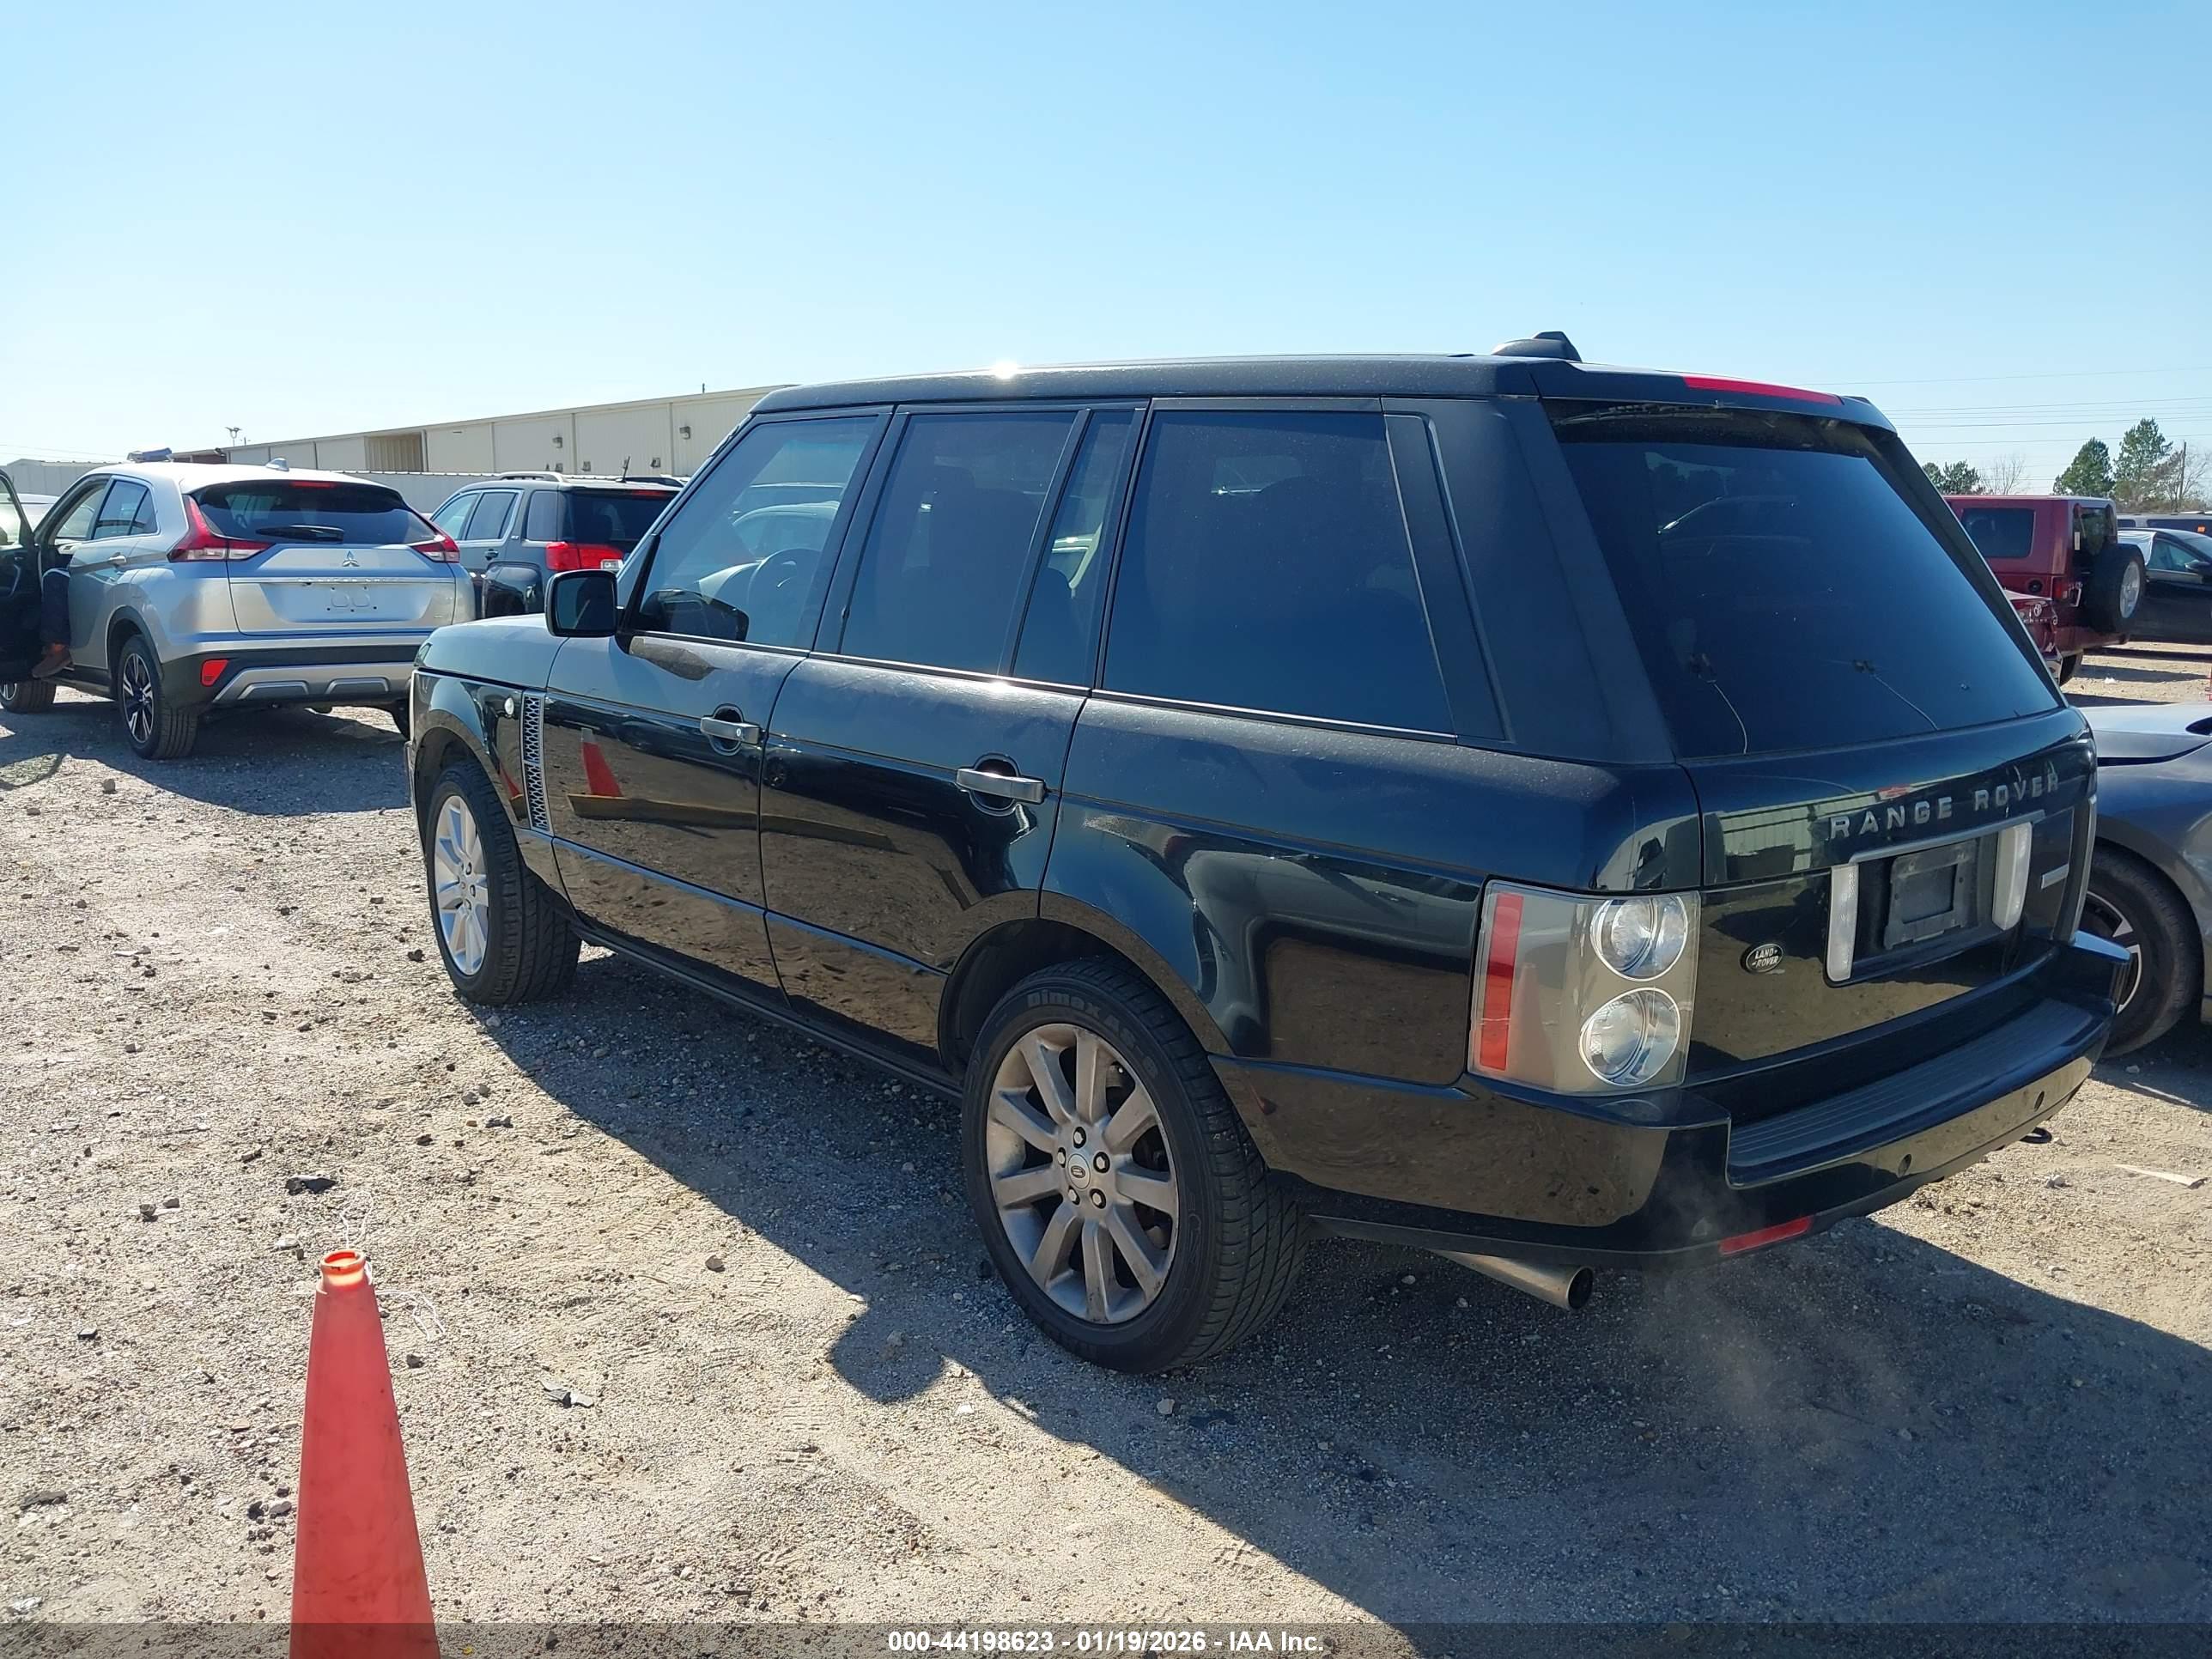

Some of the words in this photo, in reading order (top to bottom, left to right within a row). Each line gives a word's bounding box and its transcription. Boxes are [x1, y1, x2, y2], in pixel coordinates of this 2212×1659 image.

[1830, 797, 1954, 839] RANGE
[1975, 772, 2058, 811] ROVER
[1754, 947, 1774, 960] LAND
[1755, 955, 1779, 968] ROVER
